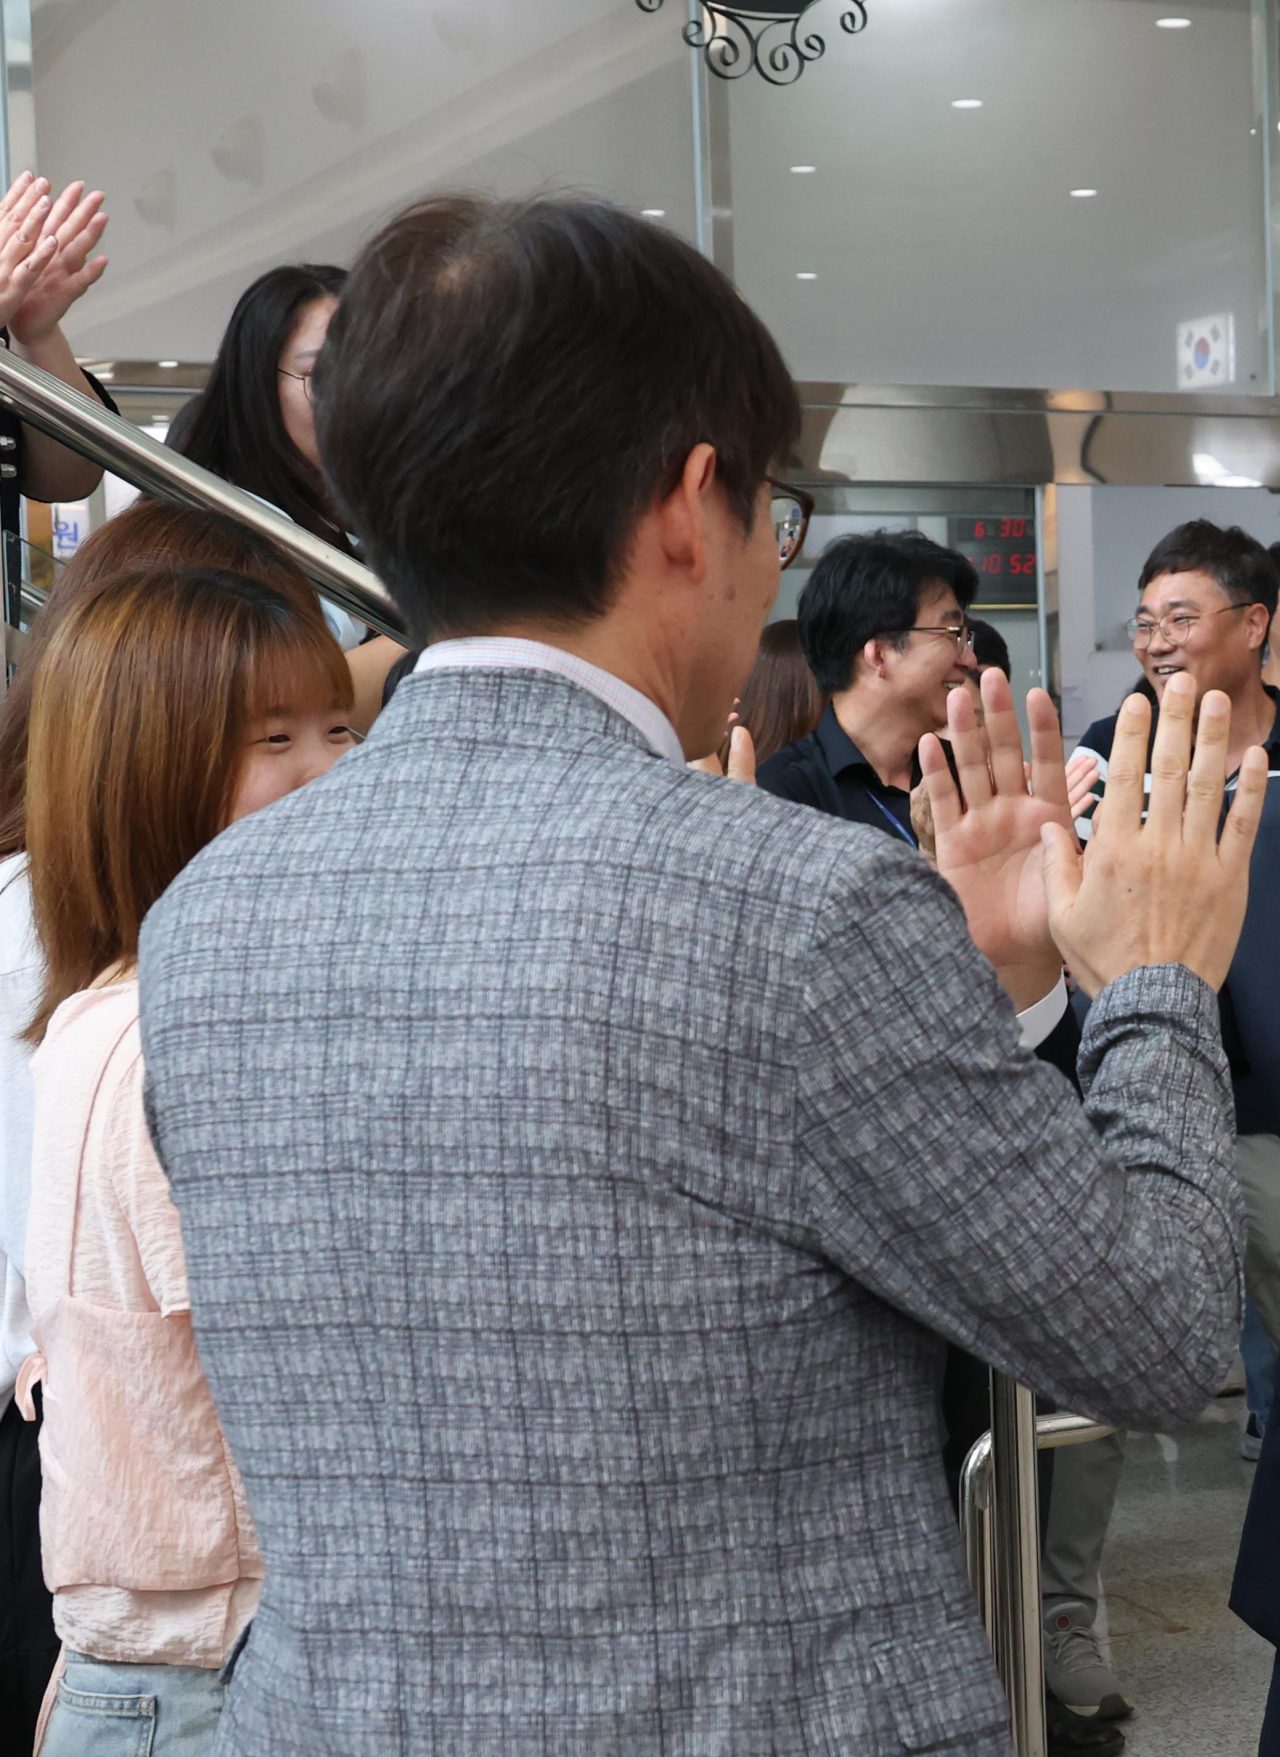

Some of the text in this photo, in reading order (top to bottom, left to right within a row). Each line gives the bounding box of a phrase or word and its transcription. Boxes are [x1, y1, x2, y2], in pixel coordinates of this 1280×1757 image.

[973, 517, 1024, 538] 6 30
[1009, 554, 1036, 575] 52
